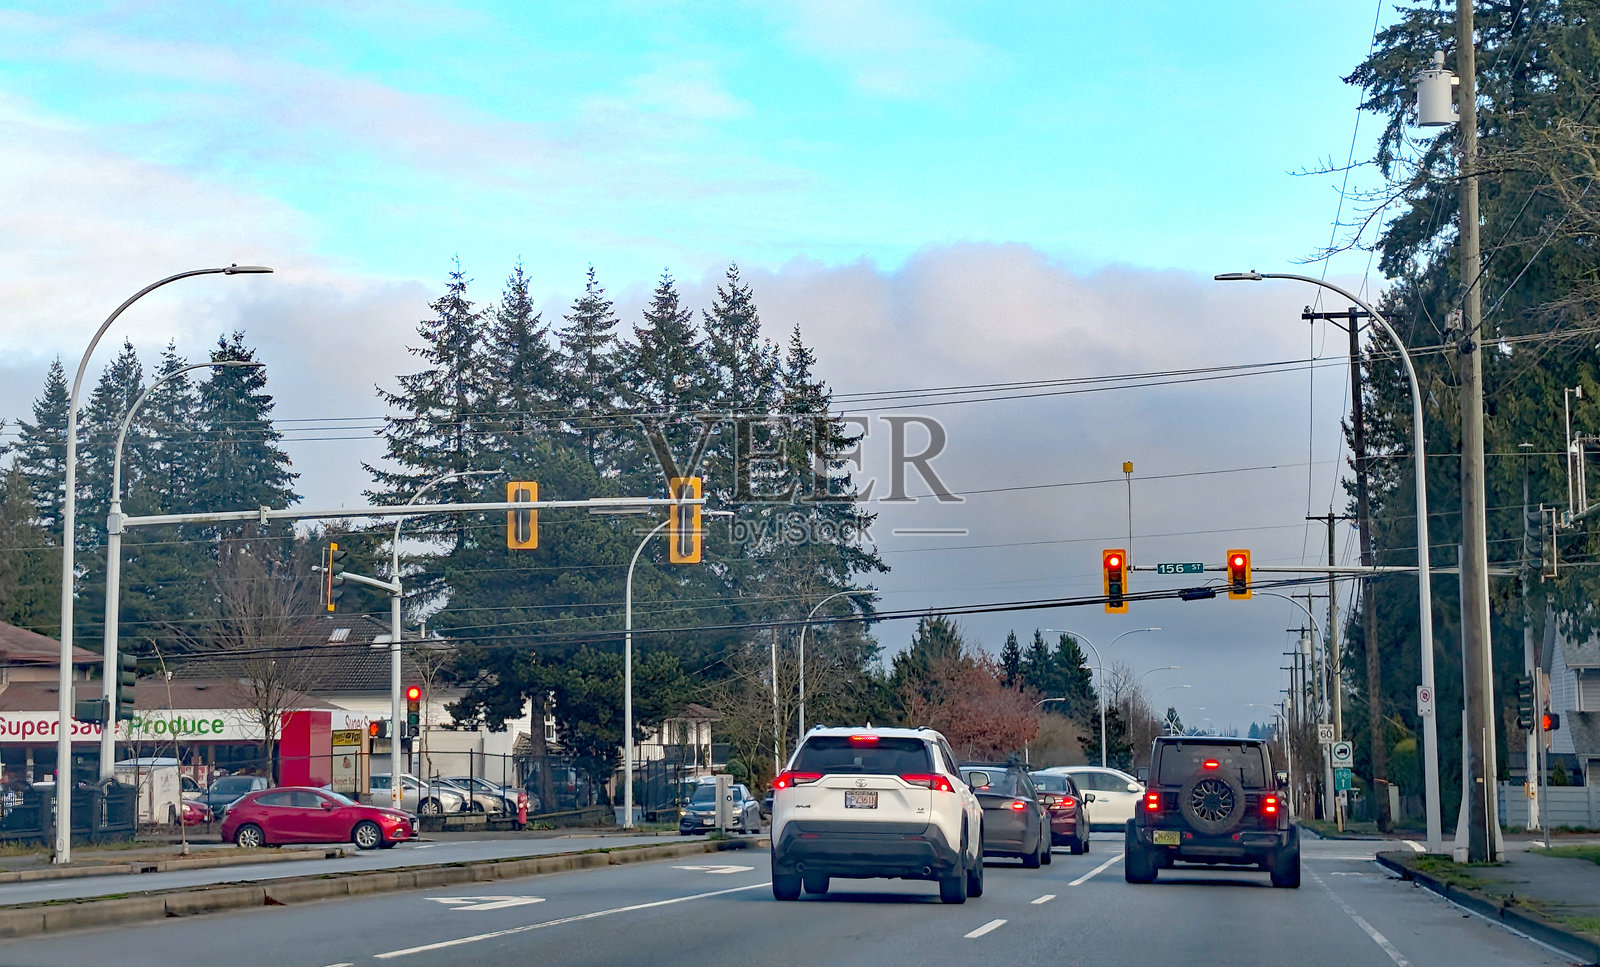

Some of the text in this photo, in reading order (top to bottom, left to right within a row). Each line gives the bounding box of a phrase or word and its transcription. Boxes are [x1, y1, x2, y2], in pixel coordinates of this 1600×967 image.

[1159, 564, 1184, 573] 156
[128, 715, 224, 735] Produce
[1320, 730, 1332, 738] 60
